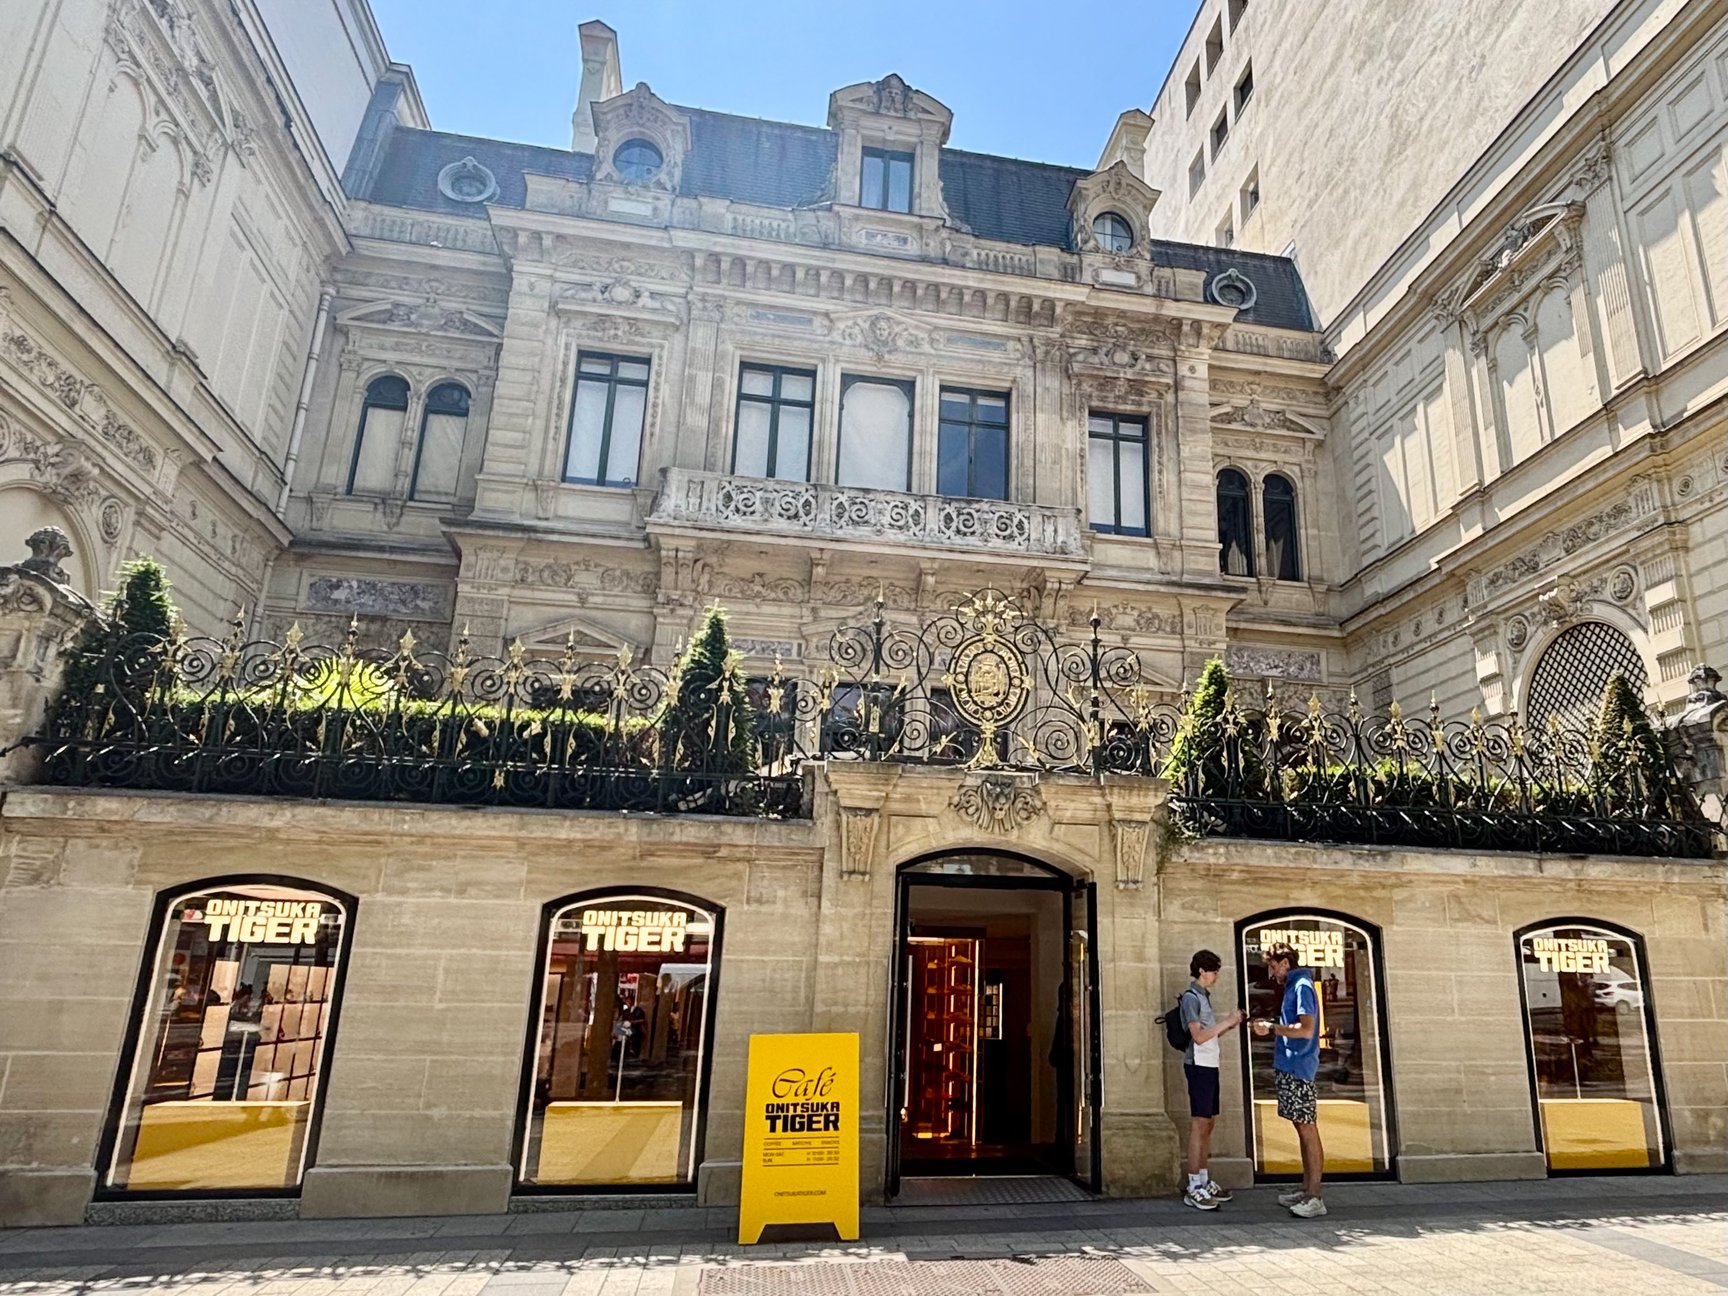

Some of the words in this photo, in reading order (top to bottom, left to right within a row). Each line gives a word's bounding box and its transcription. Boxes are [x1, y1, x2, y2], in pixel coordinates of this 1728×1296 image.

[205, 899, 322, 918] ONITSUKA
[582, 910, 687, 926] ONITSUKA
[203, 915, 319, 944] TIGER
[581, 925, 686, 952] TIGER
[1259, 929, 1343, 945] ONITSUKA
[1260, 943, 1345, 967] GER
[1533, 938, 1608, 953] ONITSUKA
[1534, 951, 1611, 974] TIGER
[772, 1067, 837, 1101] Café
[765, 1101, 840, 1114] ONITSUKA
[765, 1113, 840, 1133] TIGER
